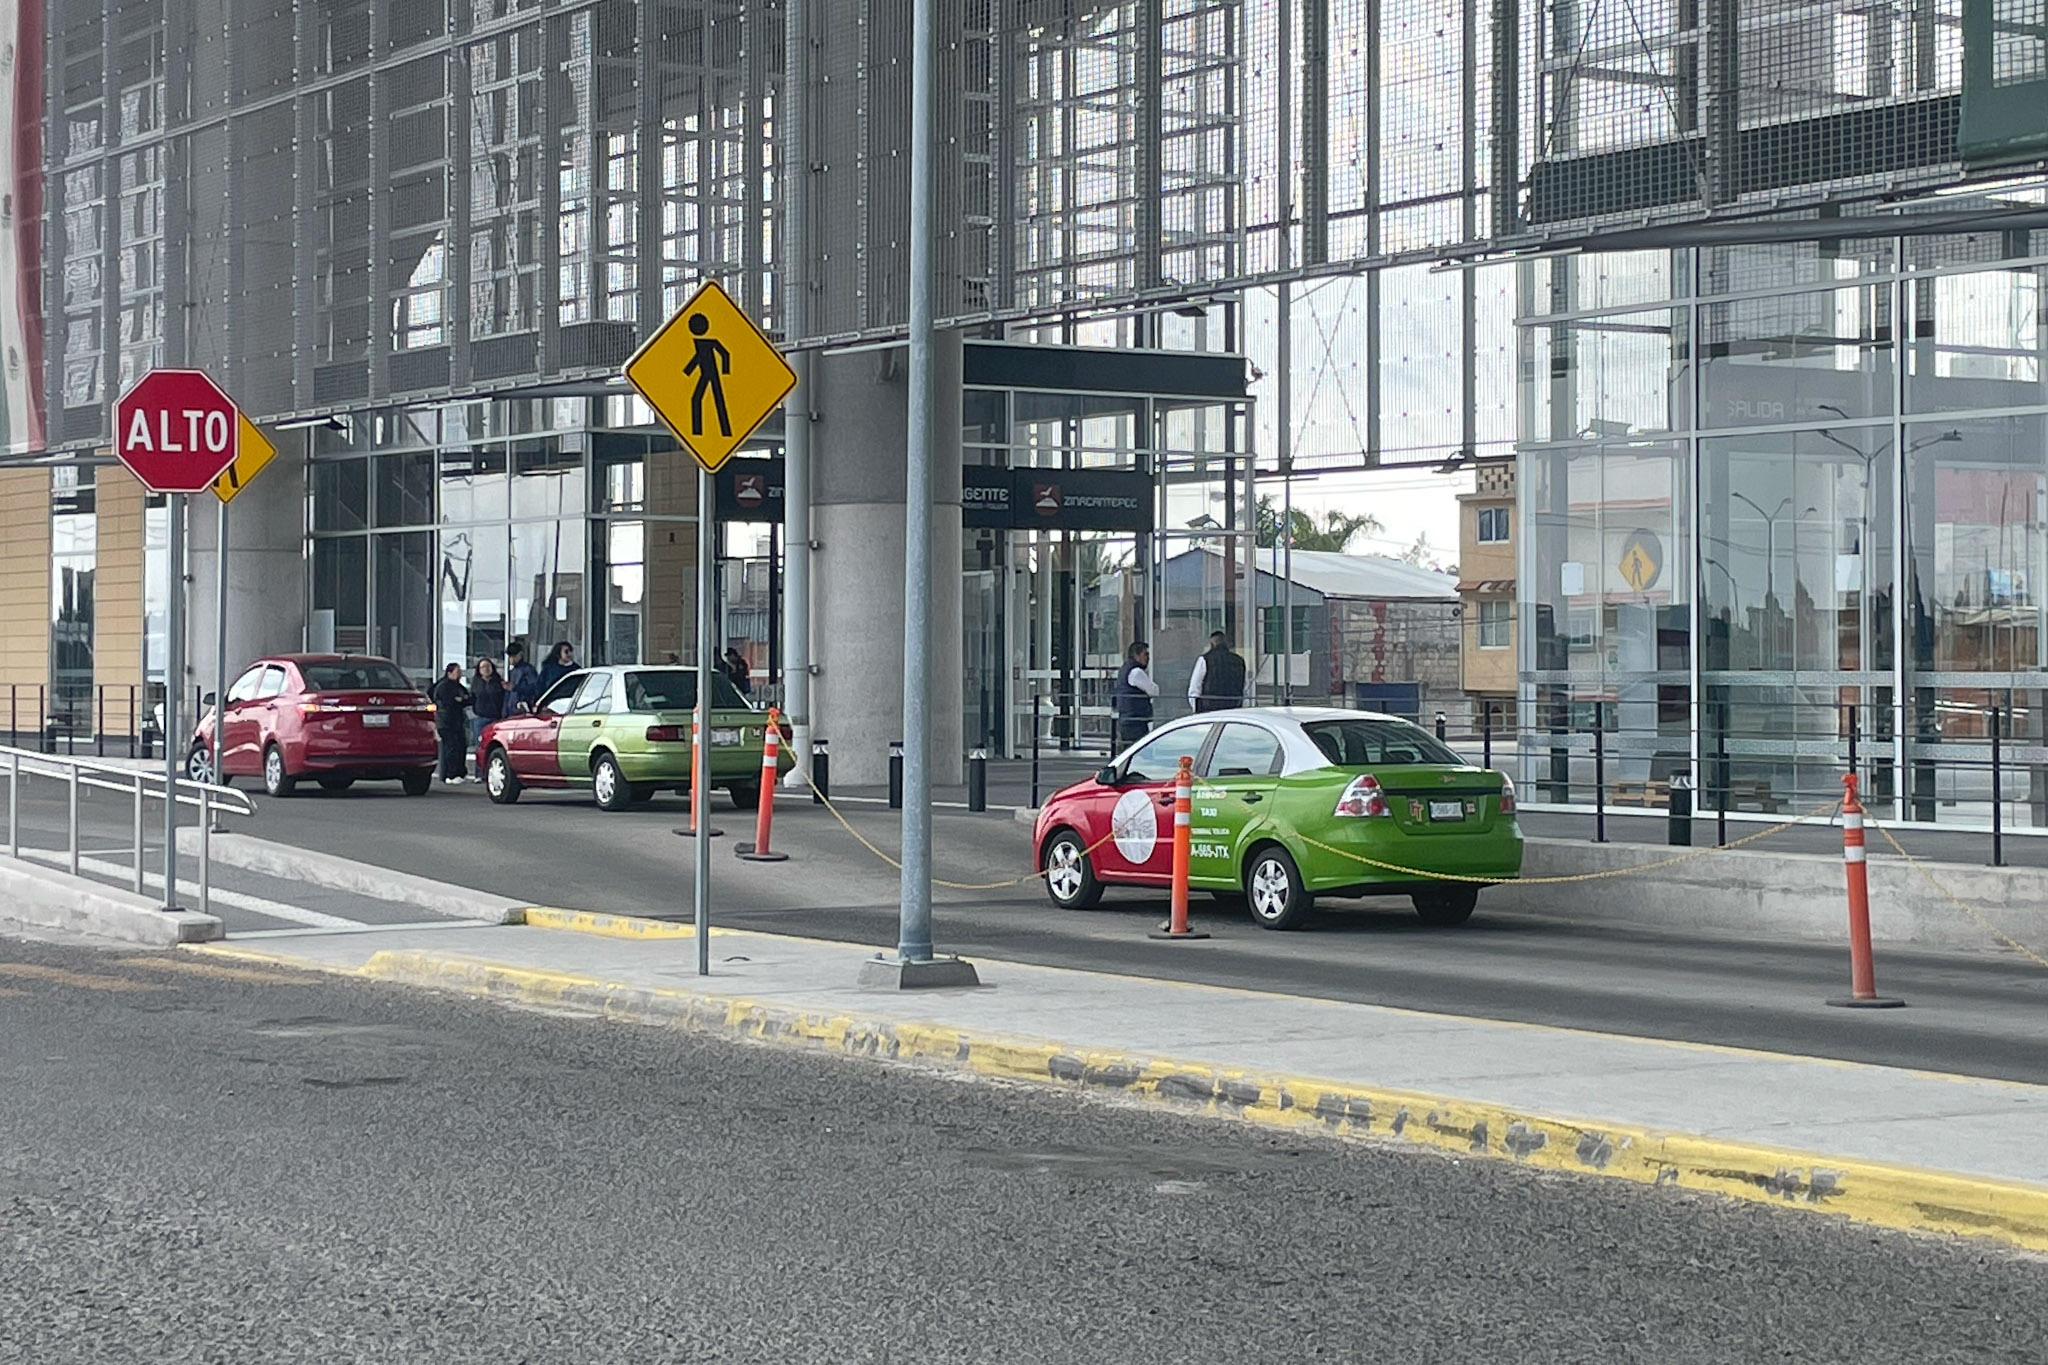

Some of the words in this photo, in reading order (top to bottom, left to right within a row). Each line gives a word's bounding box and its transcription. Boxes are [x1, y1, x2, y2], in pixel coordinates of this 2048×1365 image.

[1728, 399, 1785, 419] SALIDA
[126, 408, 229, 453] ALTO
[963, 487, 1009, 501] GENTE
[1064, 496, 1138, 509] ZINACANTEPEC
[1200, 807, 1218, 818] TAXI
